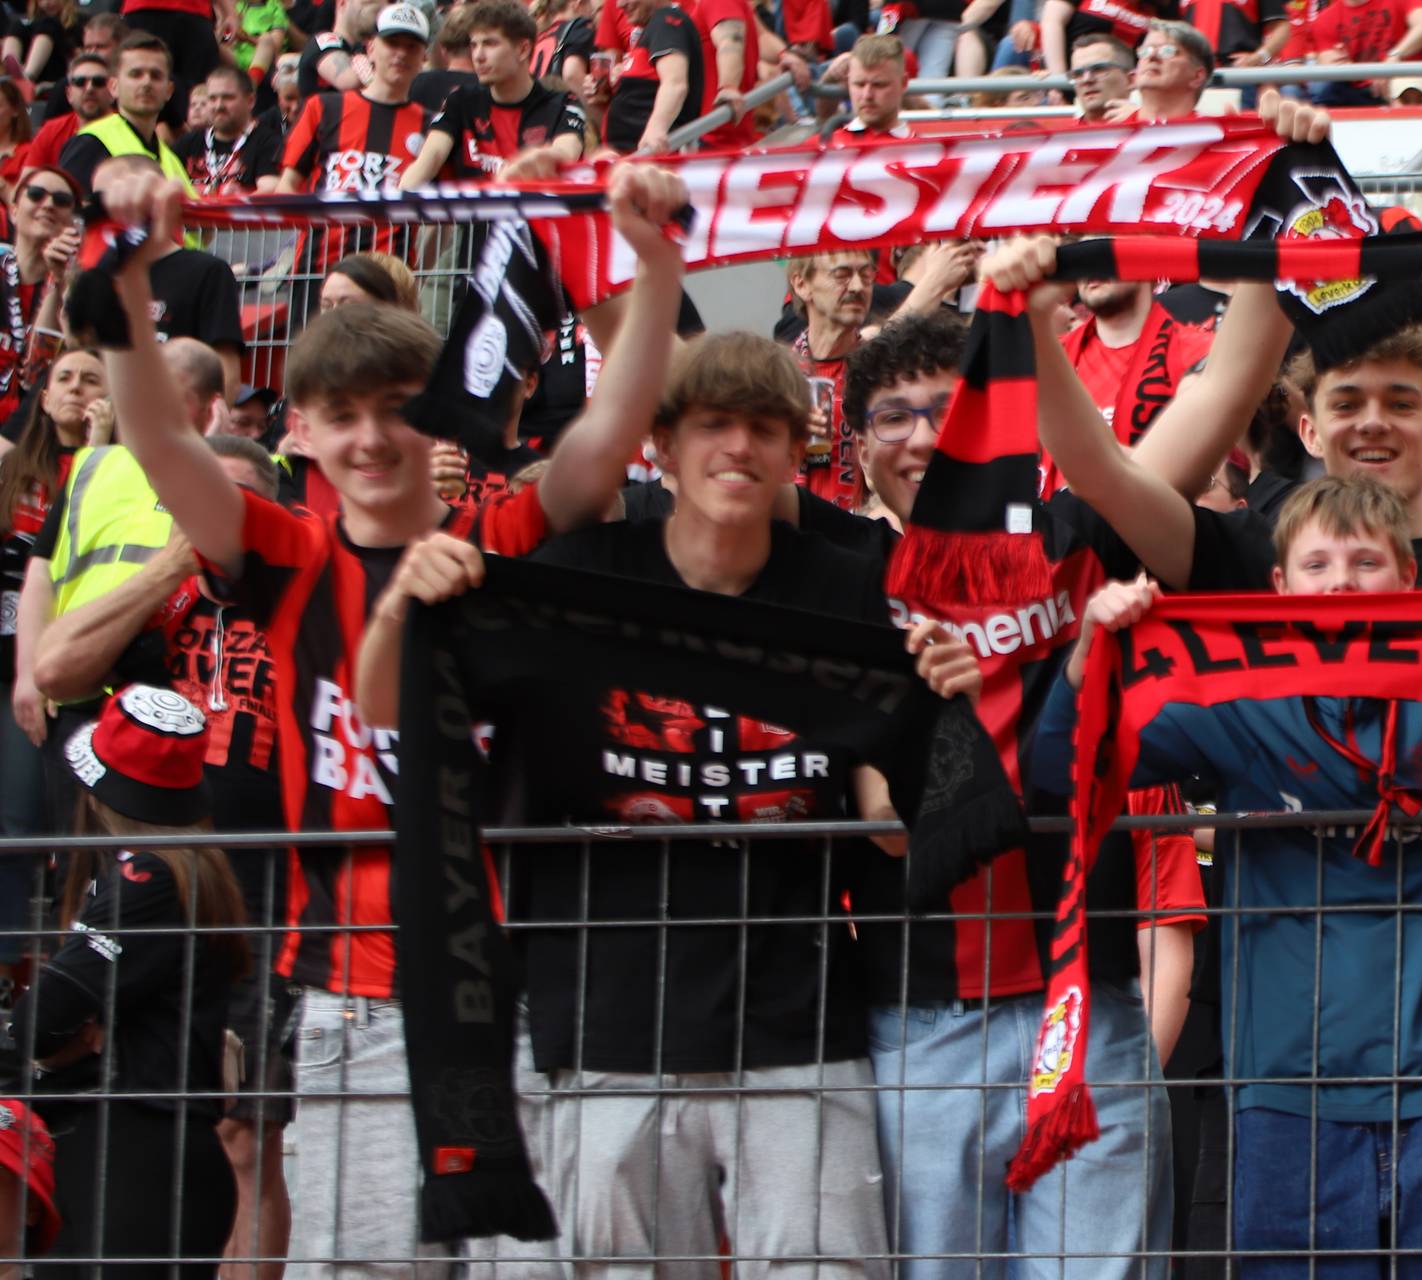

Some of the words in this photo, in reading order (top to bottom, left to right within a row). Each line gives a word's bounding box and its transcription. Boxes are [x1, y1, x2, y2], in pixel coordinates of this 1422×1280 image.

[325, 149, 403, 176] FORZ
[325, 171, 402, 194] BAYE
[1152, 191, 1244, 233] 2024
[602, 750, 830, 788] MEISTER
